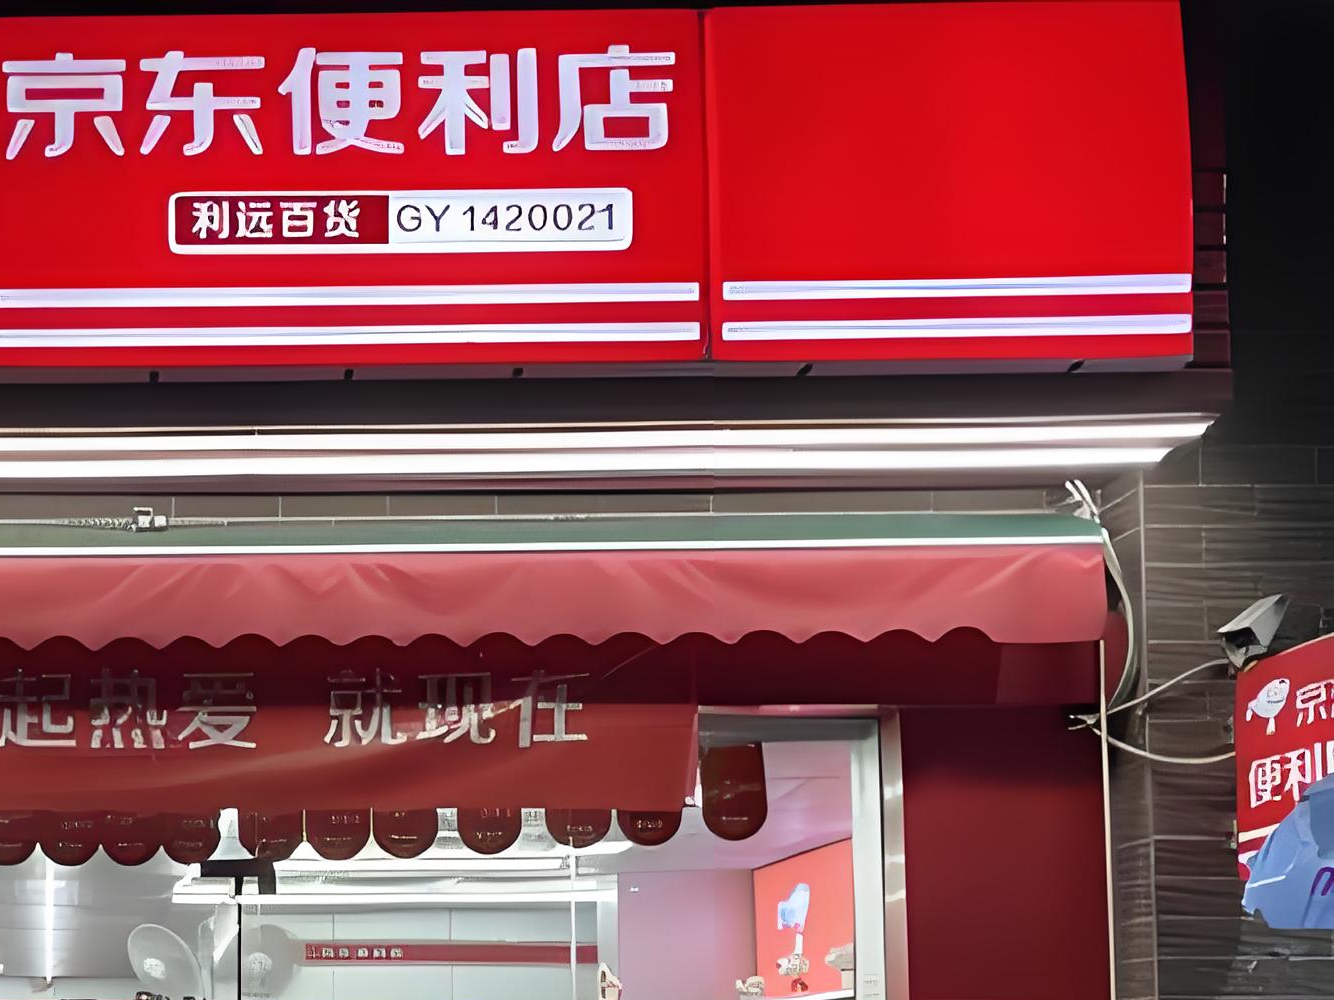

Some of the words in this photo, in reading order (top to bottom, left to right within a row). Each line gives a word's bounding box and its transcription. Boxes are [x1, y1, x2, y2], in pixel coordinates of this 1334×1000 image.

[3, 44, 676, 160] 京东便利店
[191, 200, 361, 240] 利远百货
[396, 203, 451, 233] GY
[462, 203, 616, 232] 1420021
[323, 668, 590, 749] 就现在
[1296, 679, 1334, 728] 京
[1248, 740, 1334, 809] 便利
